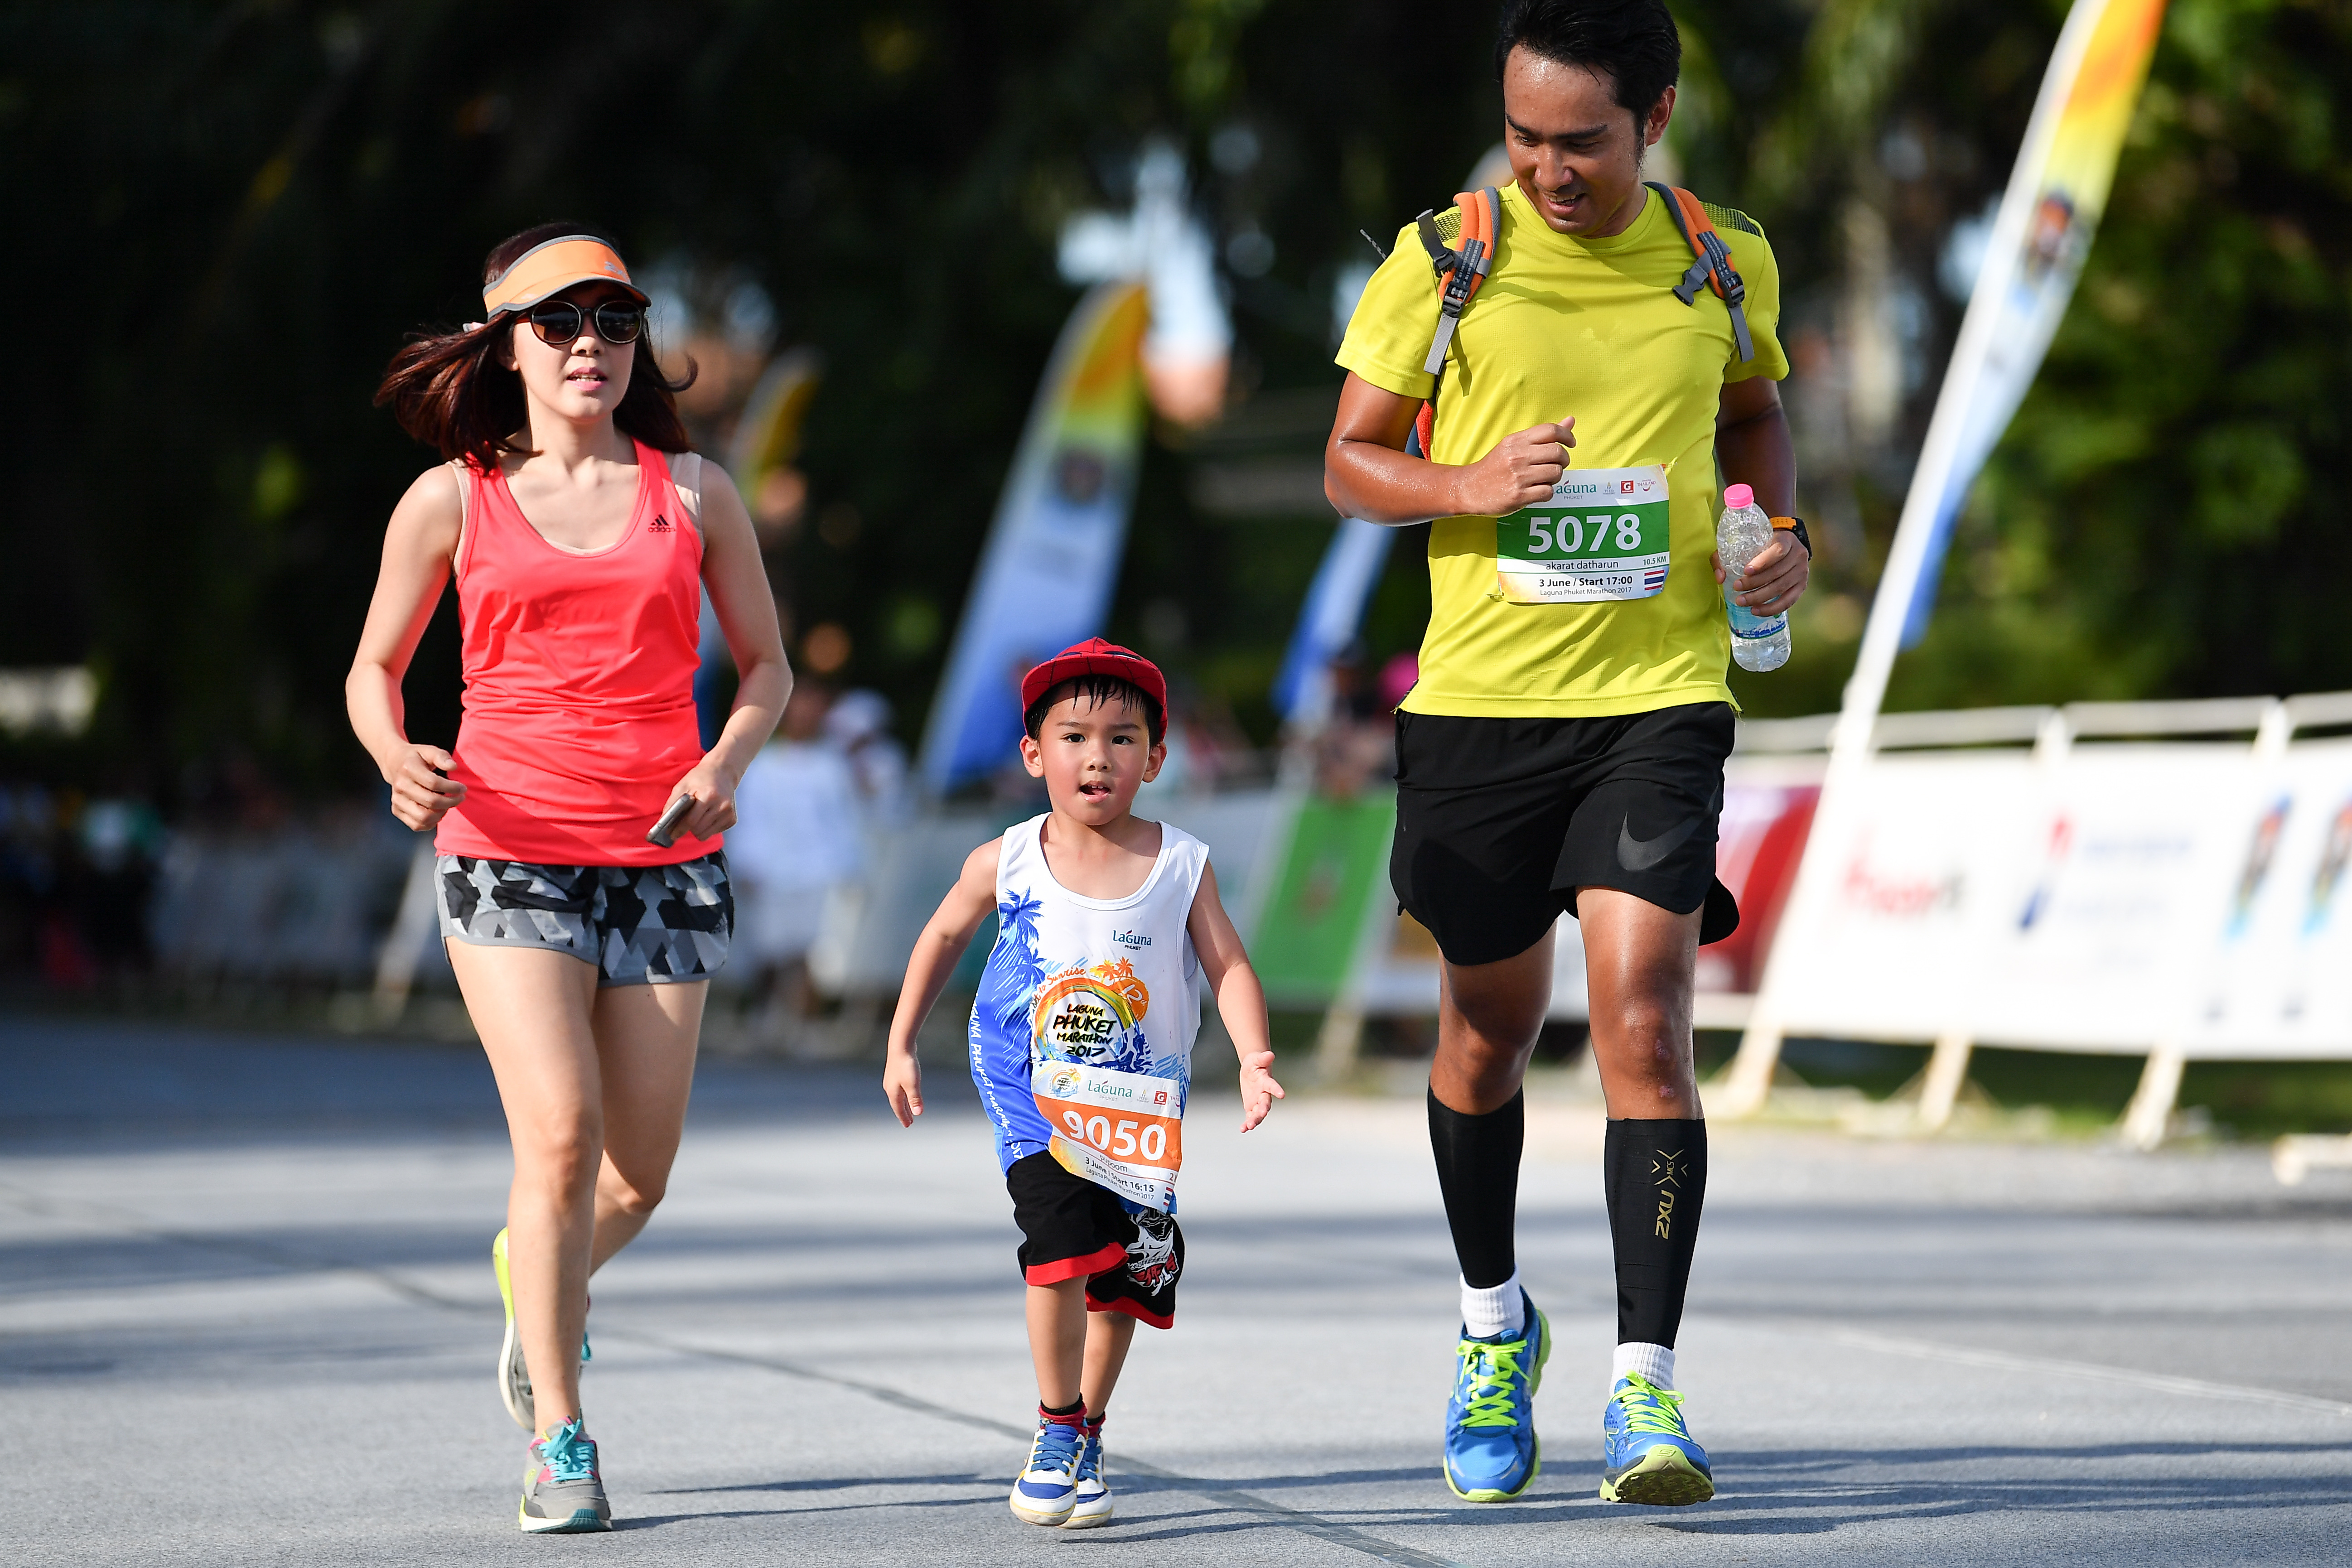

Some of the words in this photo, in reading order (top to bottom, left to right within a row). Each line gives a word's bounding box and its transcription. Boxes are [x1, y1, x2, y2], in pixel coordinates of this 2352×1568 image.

[1528, 513, 1642, 553] 5078
[1546, 561, 1574, 570] akarat
[1577, 560, 1618, 569] datharun
[1547, 579, 1571, 587] June
[1573, 578, 1577, 587] /
[1579, 578, 1603, 586] Start
[1606, 576, 1632, 585] 17:00
[1039, 985, 1046, 994] to
[1047, 967, 1086, 985] Sunrise
[1067, 1003, 1104, 1017] LAGUNA
[1053, 1014, 1117, 1035] PHUKET
[1057, 1032, 1113, 1044] MARATHON
[1066, 1045, 1106, 1057] 2017
[971, 1043, 994, 1089] PHUKET
[1063, 1110, 1166, 1161] 9050
[1086, 1166, 1103, 1178] Laguna
[1091, 1160, 1107, 1174] June
[1111, 1172, 1128, 1187] Start
[1130, 1182, 1154, 1192] 16:15
[1666, 1161, 1675, 1176] MCS
[1655, 1189, 1675, 1240] 2XU
